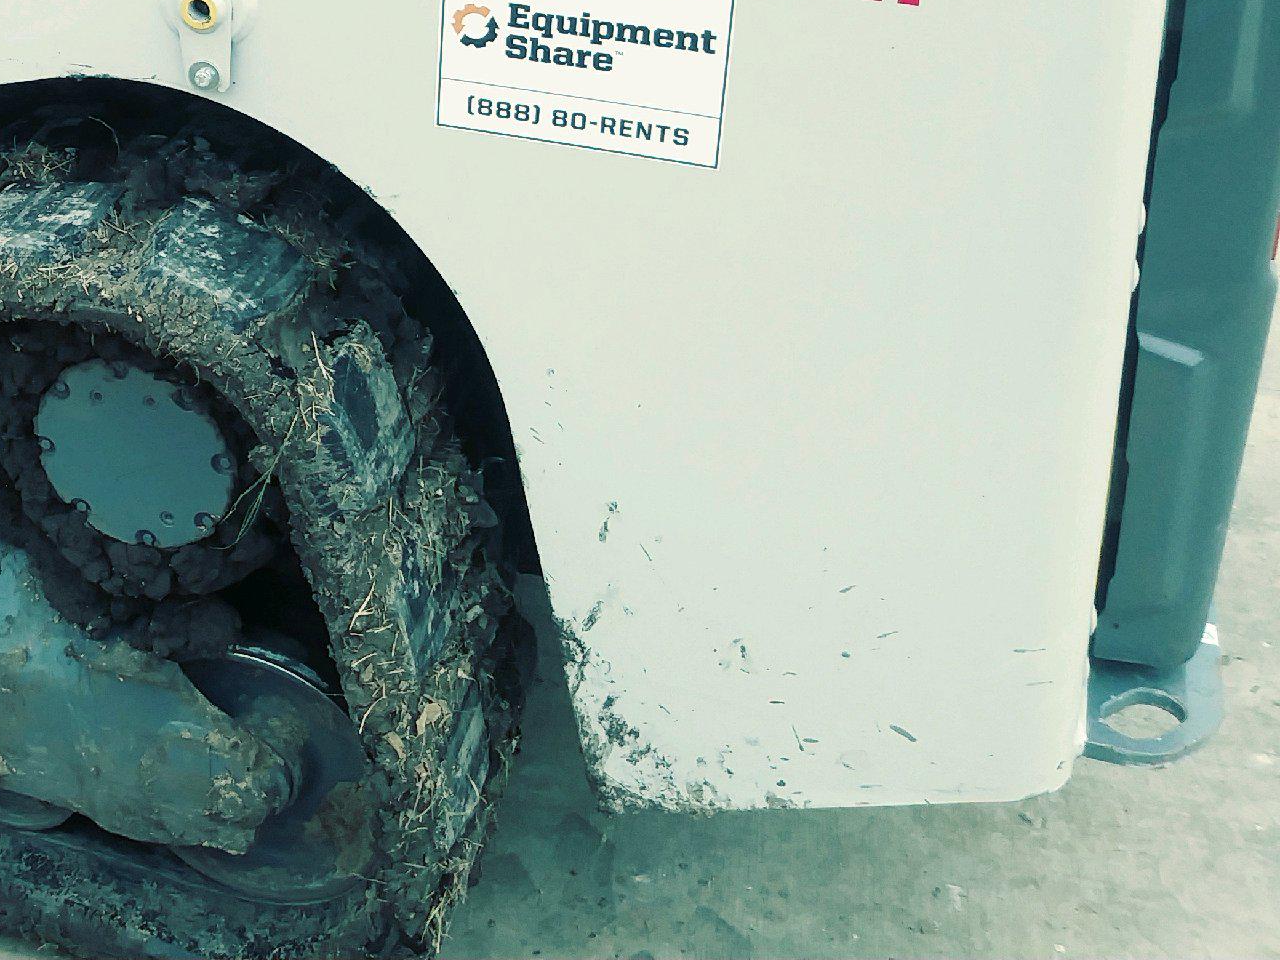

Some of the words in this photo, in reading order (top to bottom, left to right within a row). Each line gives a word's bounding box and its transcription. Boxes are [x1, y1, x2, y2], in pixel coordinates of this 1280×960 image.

[505, 34, 613, 72] Share
[508, 2, 717, 55] Equipment
[466, 95, 541, 125] (888)
[552, 109, 690, 147] 80-RENTS
